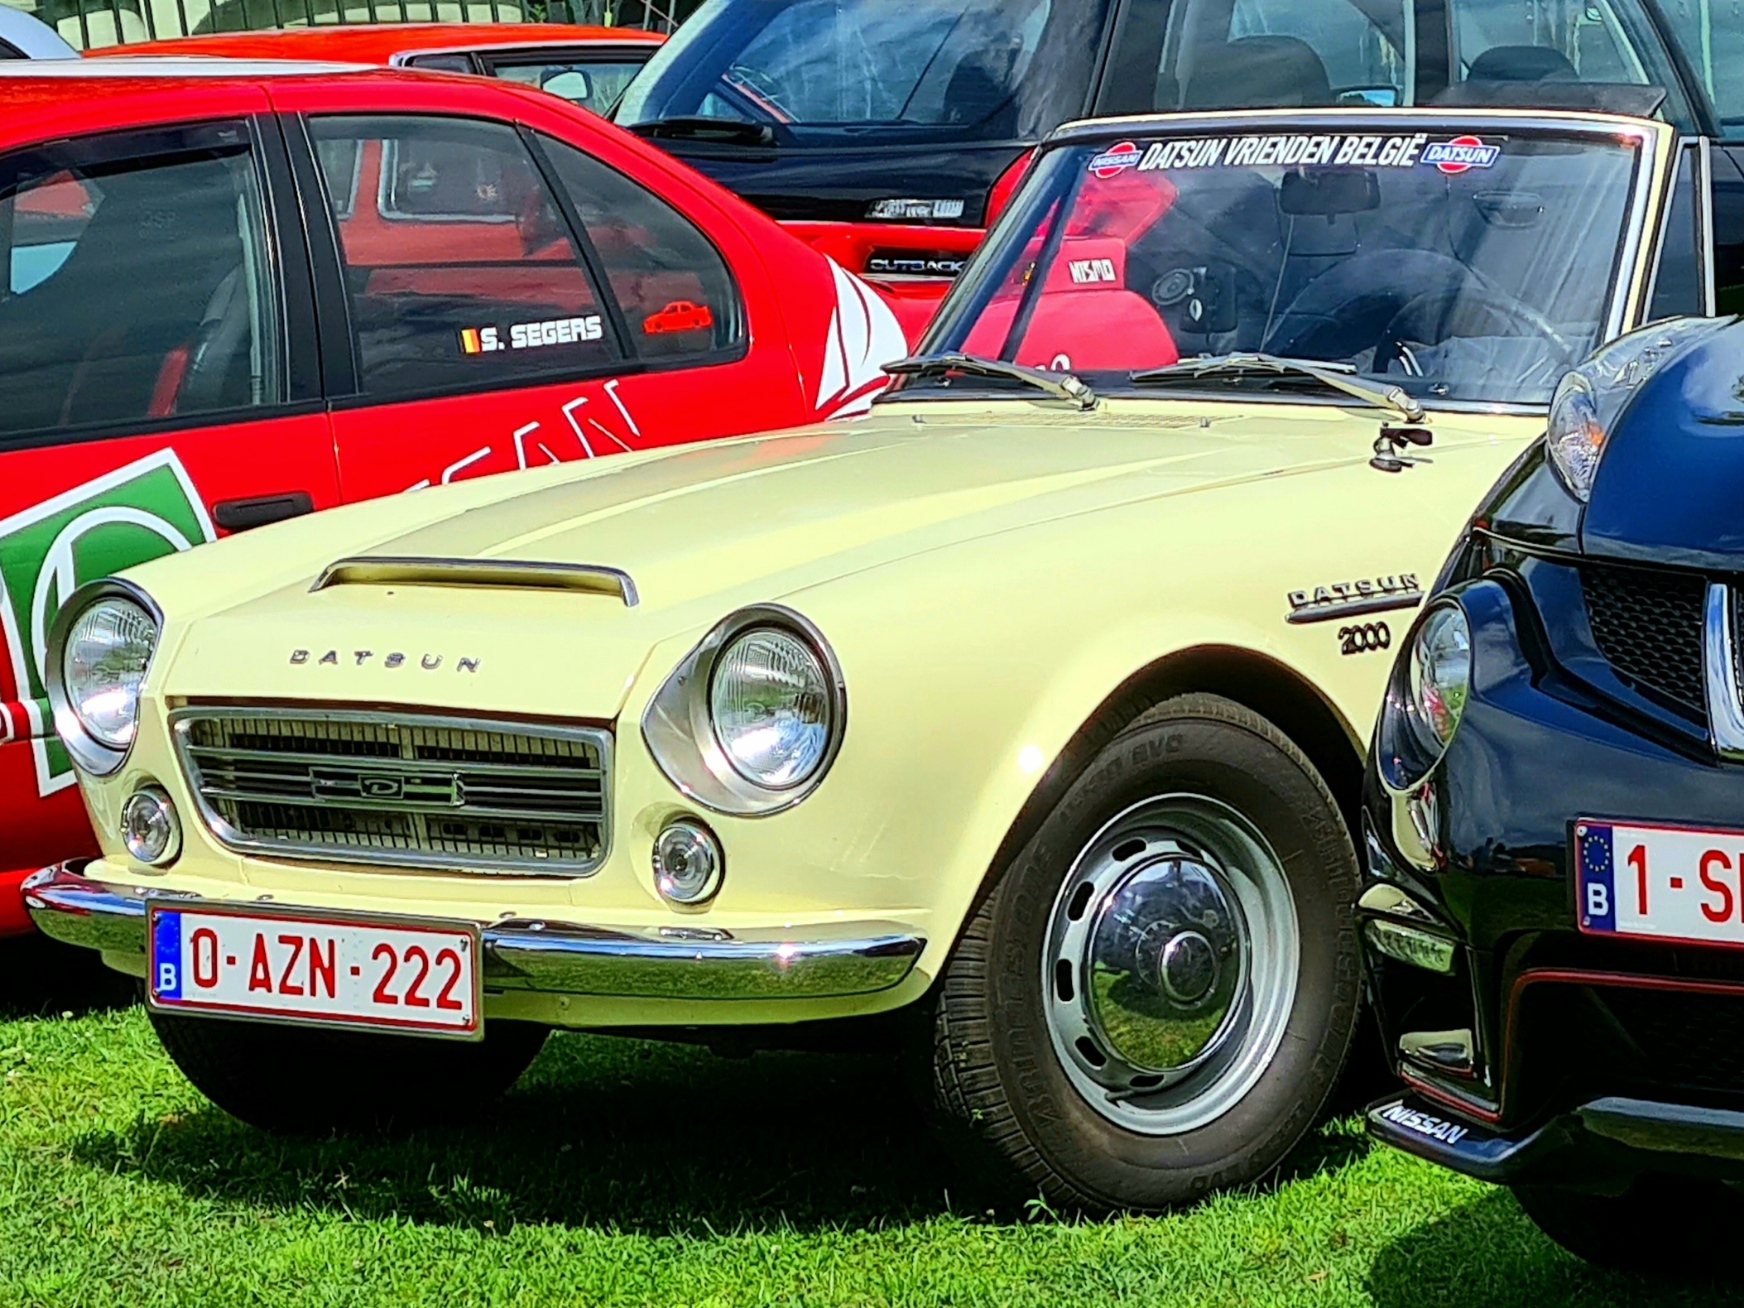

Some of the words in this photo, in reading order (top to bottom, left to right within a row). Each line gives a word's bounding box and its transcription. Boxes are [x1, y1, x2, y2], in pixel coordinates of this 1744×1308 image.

[1093, 154, 1140, 168] NISSAN
[1137, 138, 1229, 171] DATSUN
[1223, 135, 1334, 166] VRIENDEN
[1333, 132, 1428, 167] BELGIË
[1427, 146, 1491, 163] DATSUN
[870, 259, 965, 271] OUTBACK
[1069, 259, 1116, 284] NISMO
[480, 327, 505, 352] S.
[510, 315, 602, 349] SEGERS
[1288, 573, 1419, 607] DATSUN
[1338, 621, 1391, 655] 2000
[290, 649, 480, 673] DATSUN
[1587, 882, 1609, 916] B
[1627, 844, 1744, 924] 1-S
[159, 962, 177, 991] B
[1382, 1105, 1469, 1145] NISSAN
